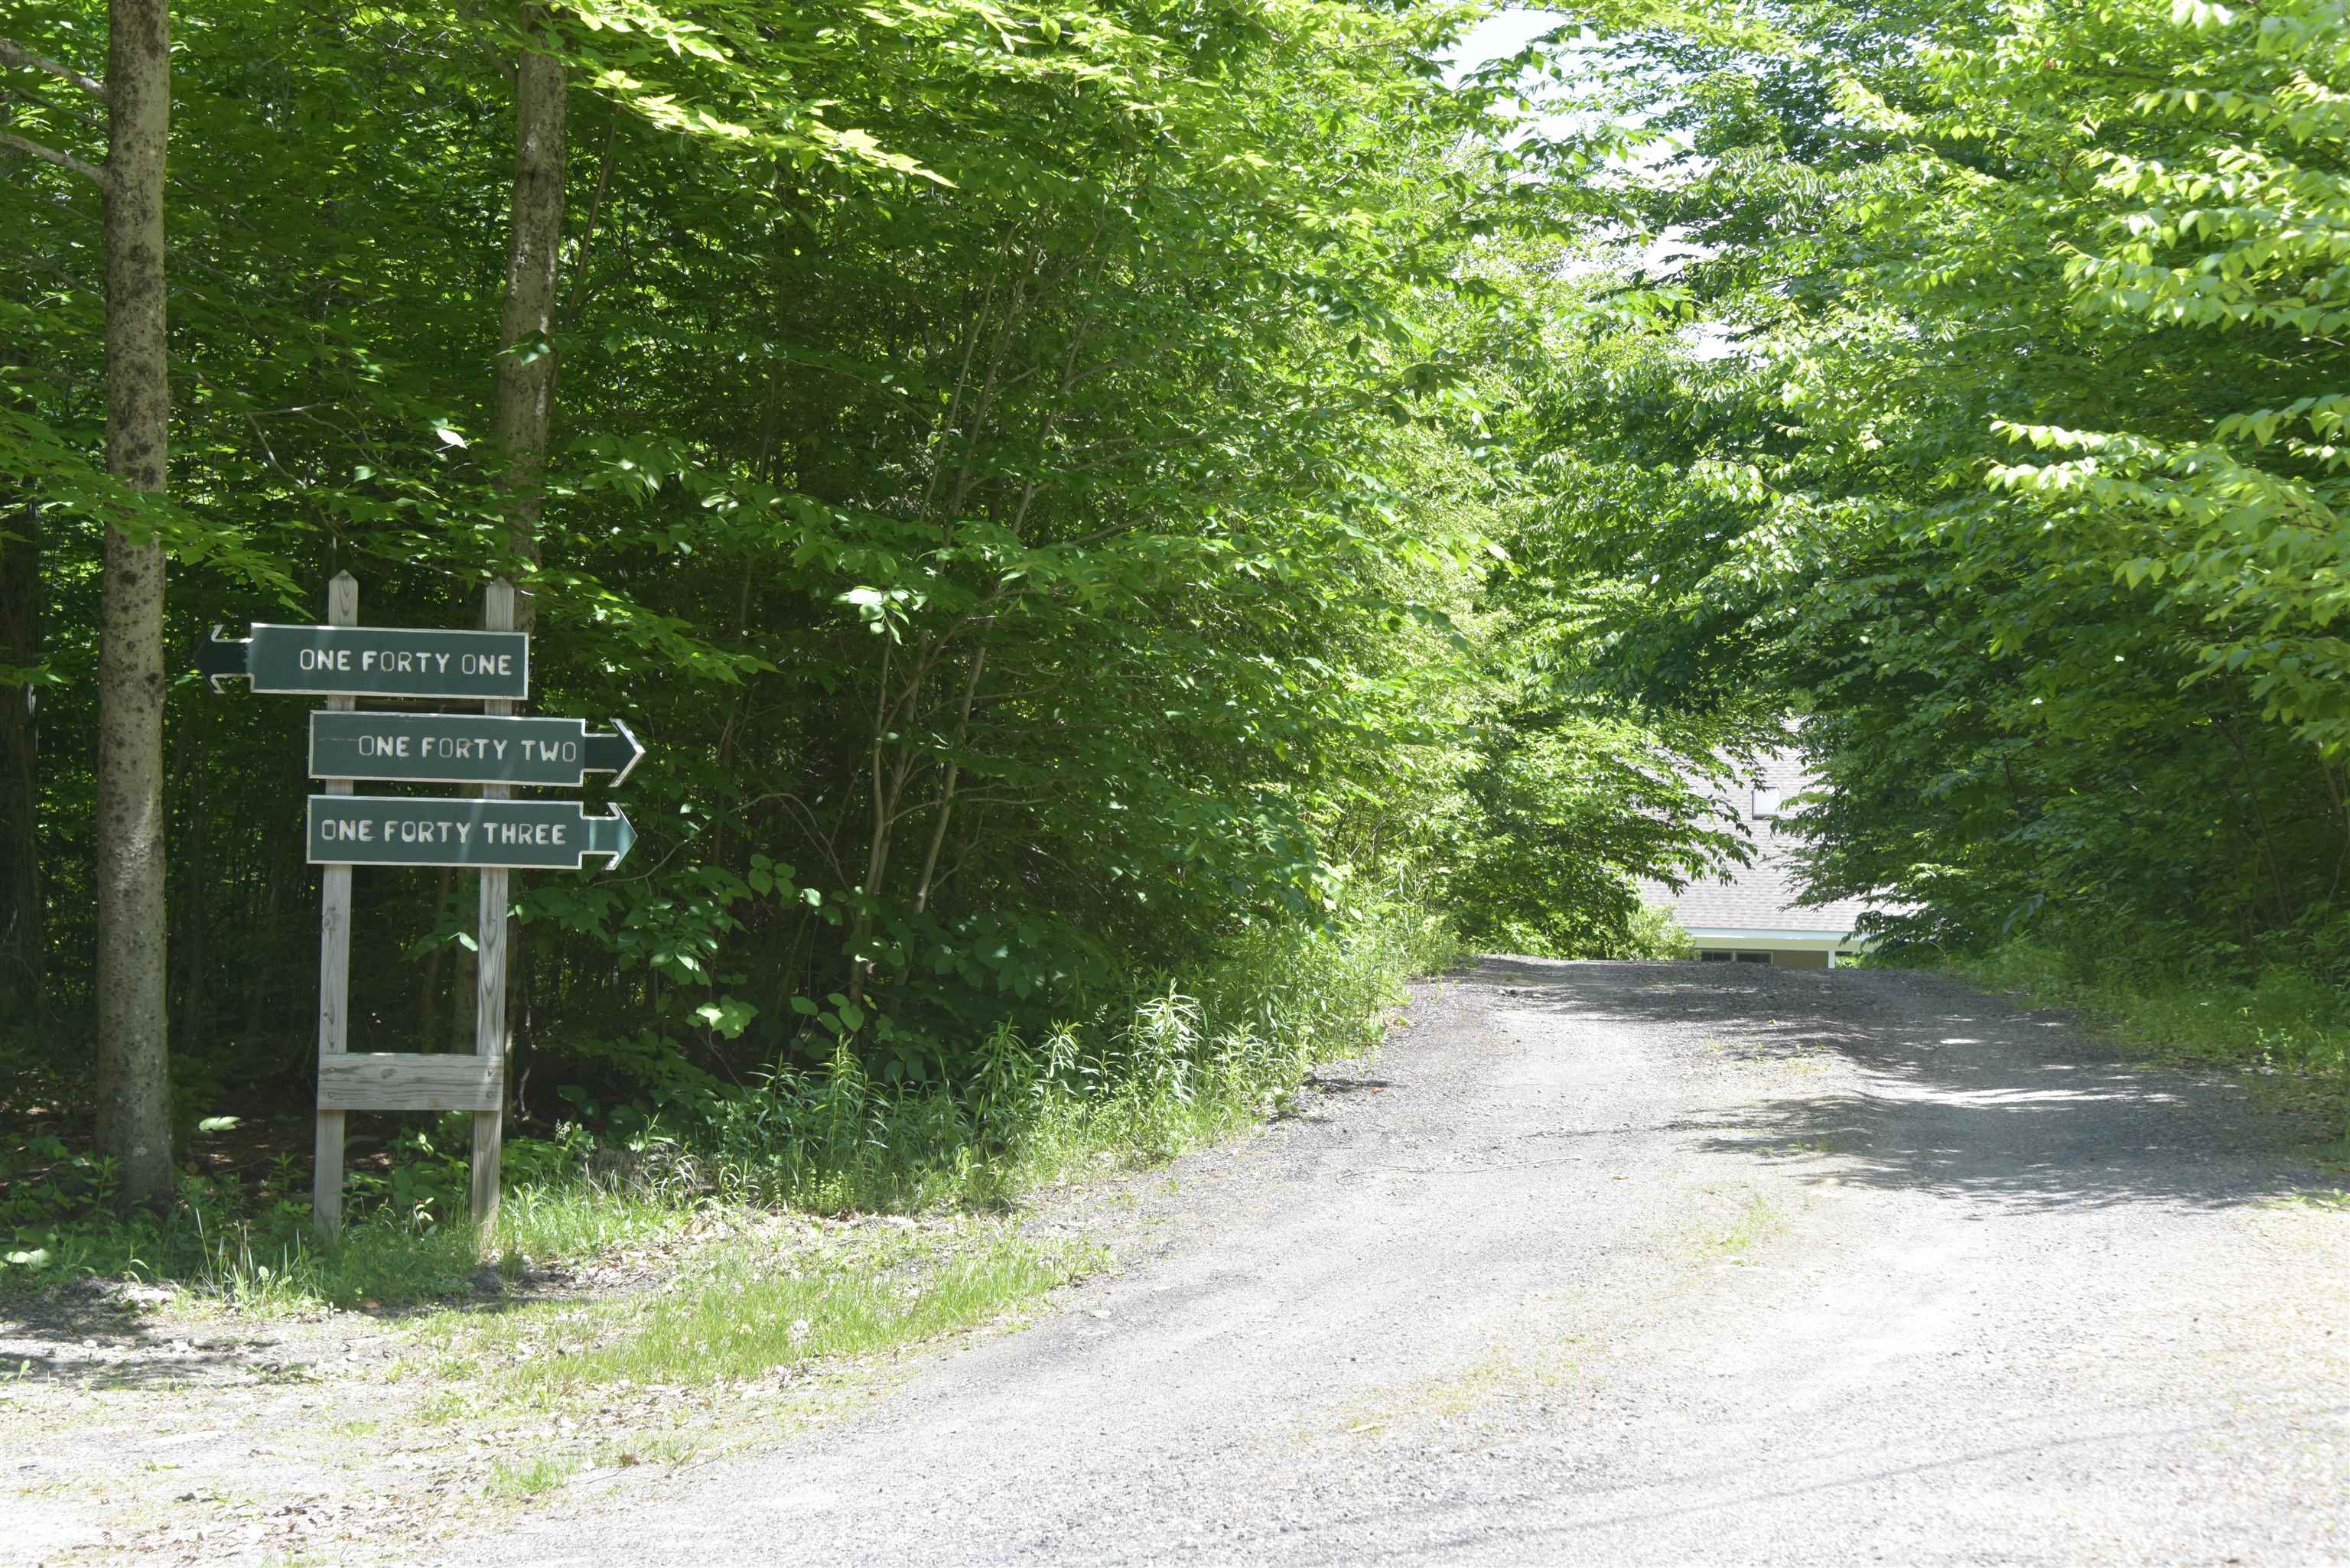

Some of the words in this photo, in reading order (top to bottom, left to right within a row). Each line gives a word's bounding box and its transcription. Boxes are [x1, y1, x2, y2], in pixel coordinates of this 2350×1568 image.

[300, 649, 351, 671] ONE
[362, 650, 451, 673] FORTY
[461, 654, 512, 675] ONE
[358, 735, 410, 757] ONE
[422, 737, 508, 760] FORTY
[521, 740, 577, 763] TWO
[321, 819, 374, 842] ONE
[384, 820, 471, 844] FORTY
[483, 822, 567, 845] THREE
